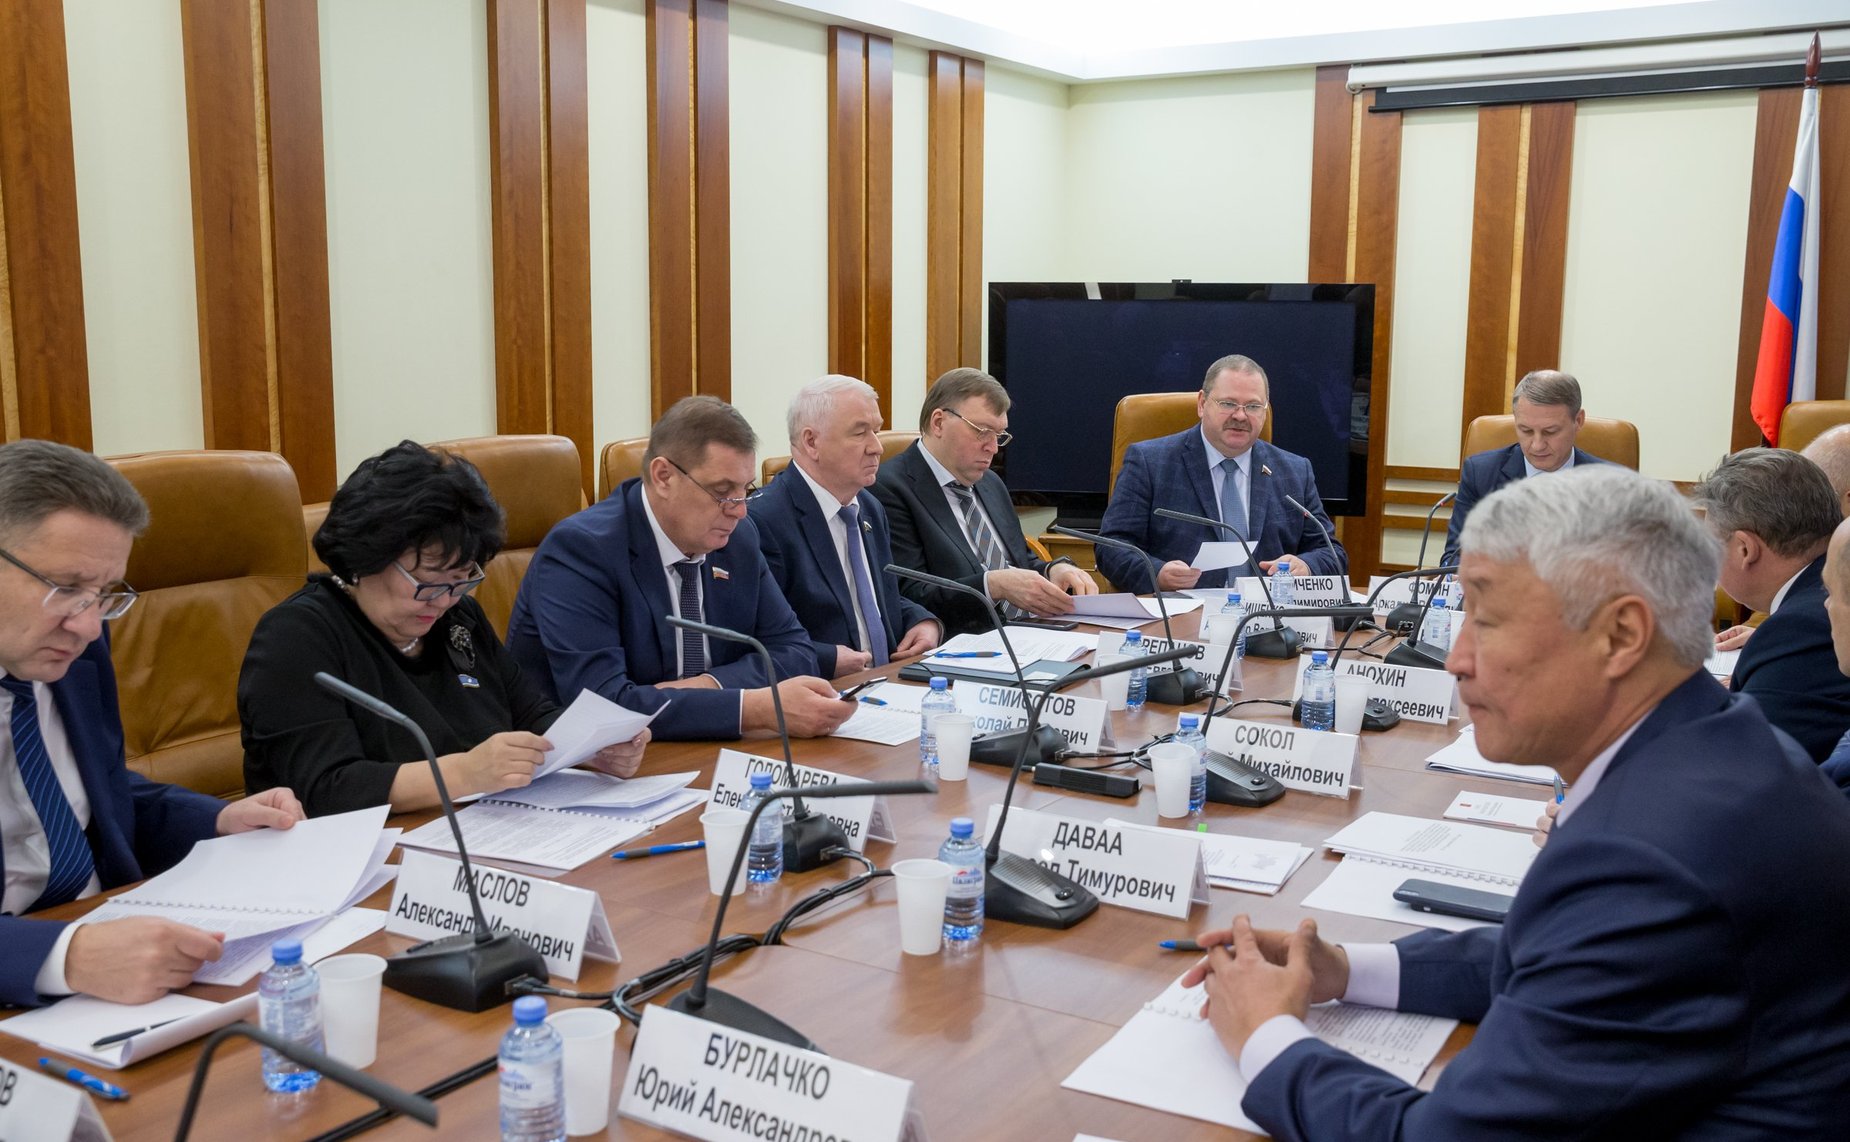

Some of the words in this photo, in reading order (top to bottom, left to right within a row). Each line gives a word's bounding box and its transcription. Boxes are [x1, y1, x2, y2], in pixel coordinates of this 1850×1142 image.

[1373, 597, 1409, 611] Арка
[1347, 663, 1406, 688] АНОХИН
[1235, 725, 1295, 751] СОКОЛ
[1240, 754, 1344, 787] Михайлович
[713, 783, 743, 809] Елен
[1052, 822, 1122, 856] ДАВАА
[453, 866, 531, 907] МАСЛОВ
[1067, 859, 1175, 902] Тимурович
[396, 893, 476, 935] Александ
[704, 1033, 830, 1100] БУРЛАЧКО
[634, 1064, 696, 1111] Юрий
